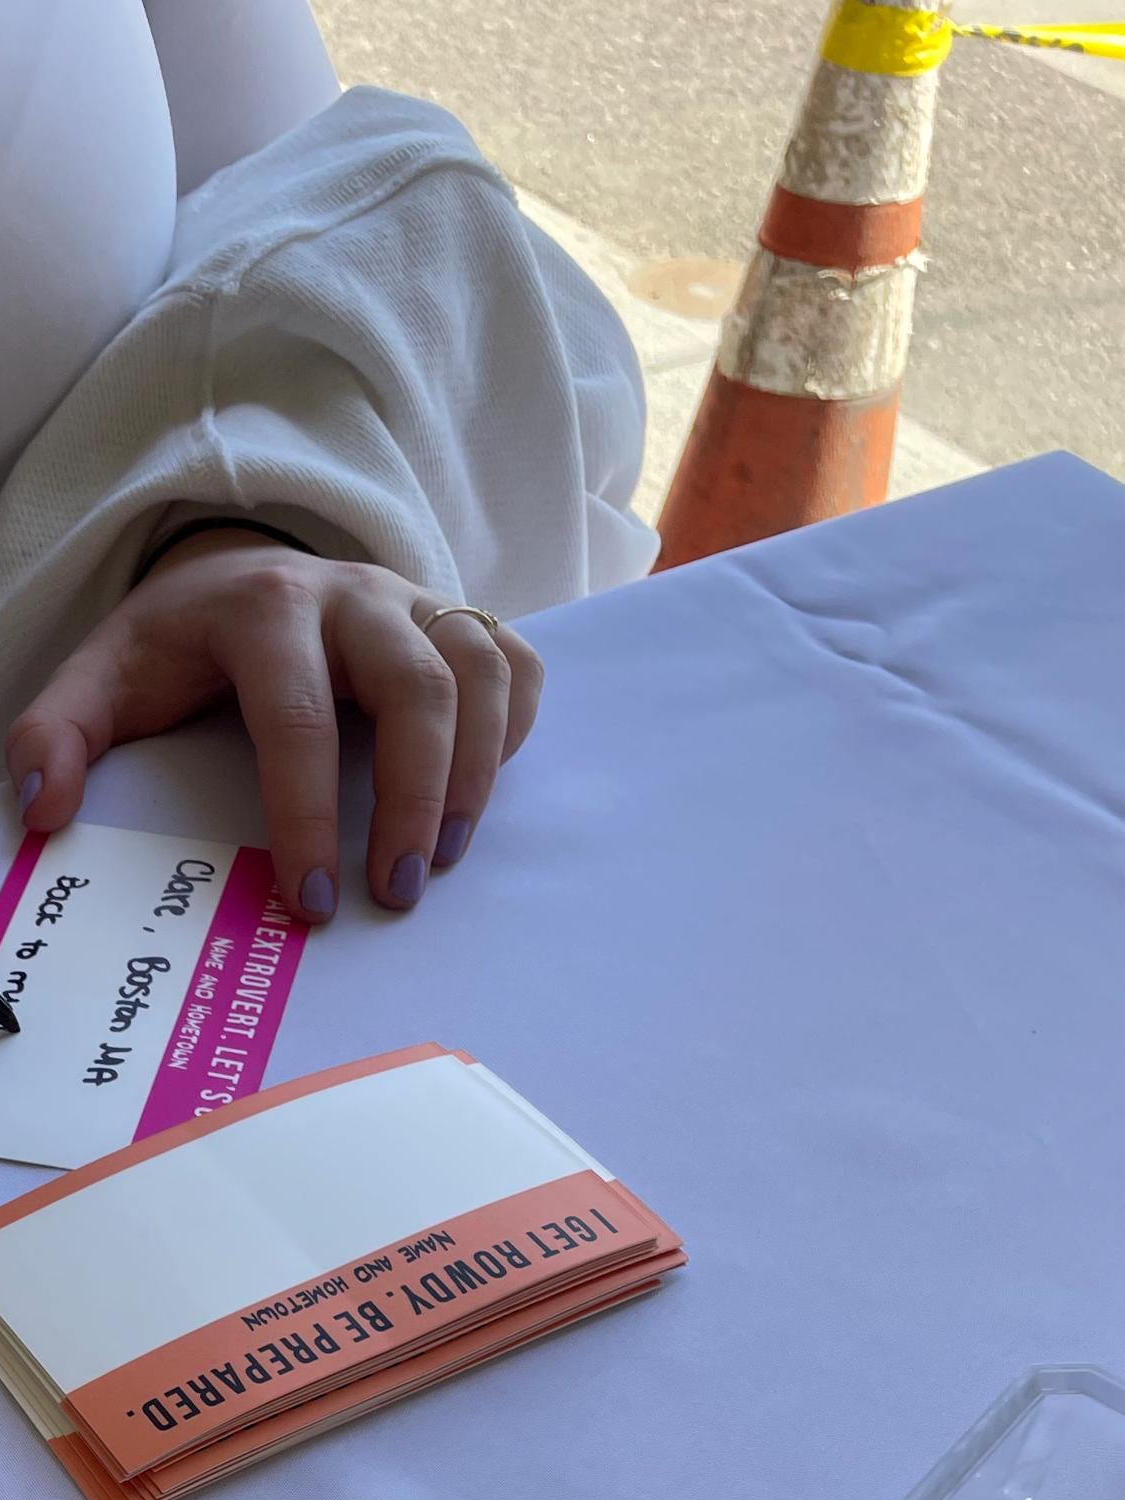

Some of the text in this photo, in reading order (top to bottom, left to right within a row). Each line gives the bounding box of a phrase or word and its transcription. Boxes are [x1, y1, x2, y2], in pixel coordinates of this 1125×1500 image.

[35, 874, 90, 927] Back
[16, 938, 49, 960] to
[218, 926, 287, 1041] EXTROVERT.
[109, 955, 171, 1032] Boston
[168, 936, 235, 1070] NAME AND HOMETOWN
[82, 1042, 133, 1087] MA
[200, 1049, 245, 1105] LET'S
[241, 1229, 457, 1332] NAME AND HOMETOWN
[126, 1208, 619, 1433] I GET ROWDY. BE PREPARED.
